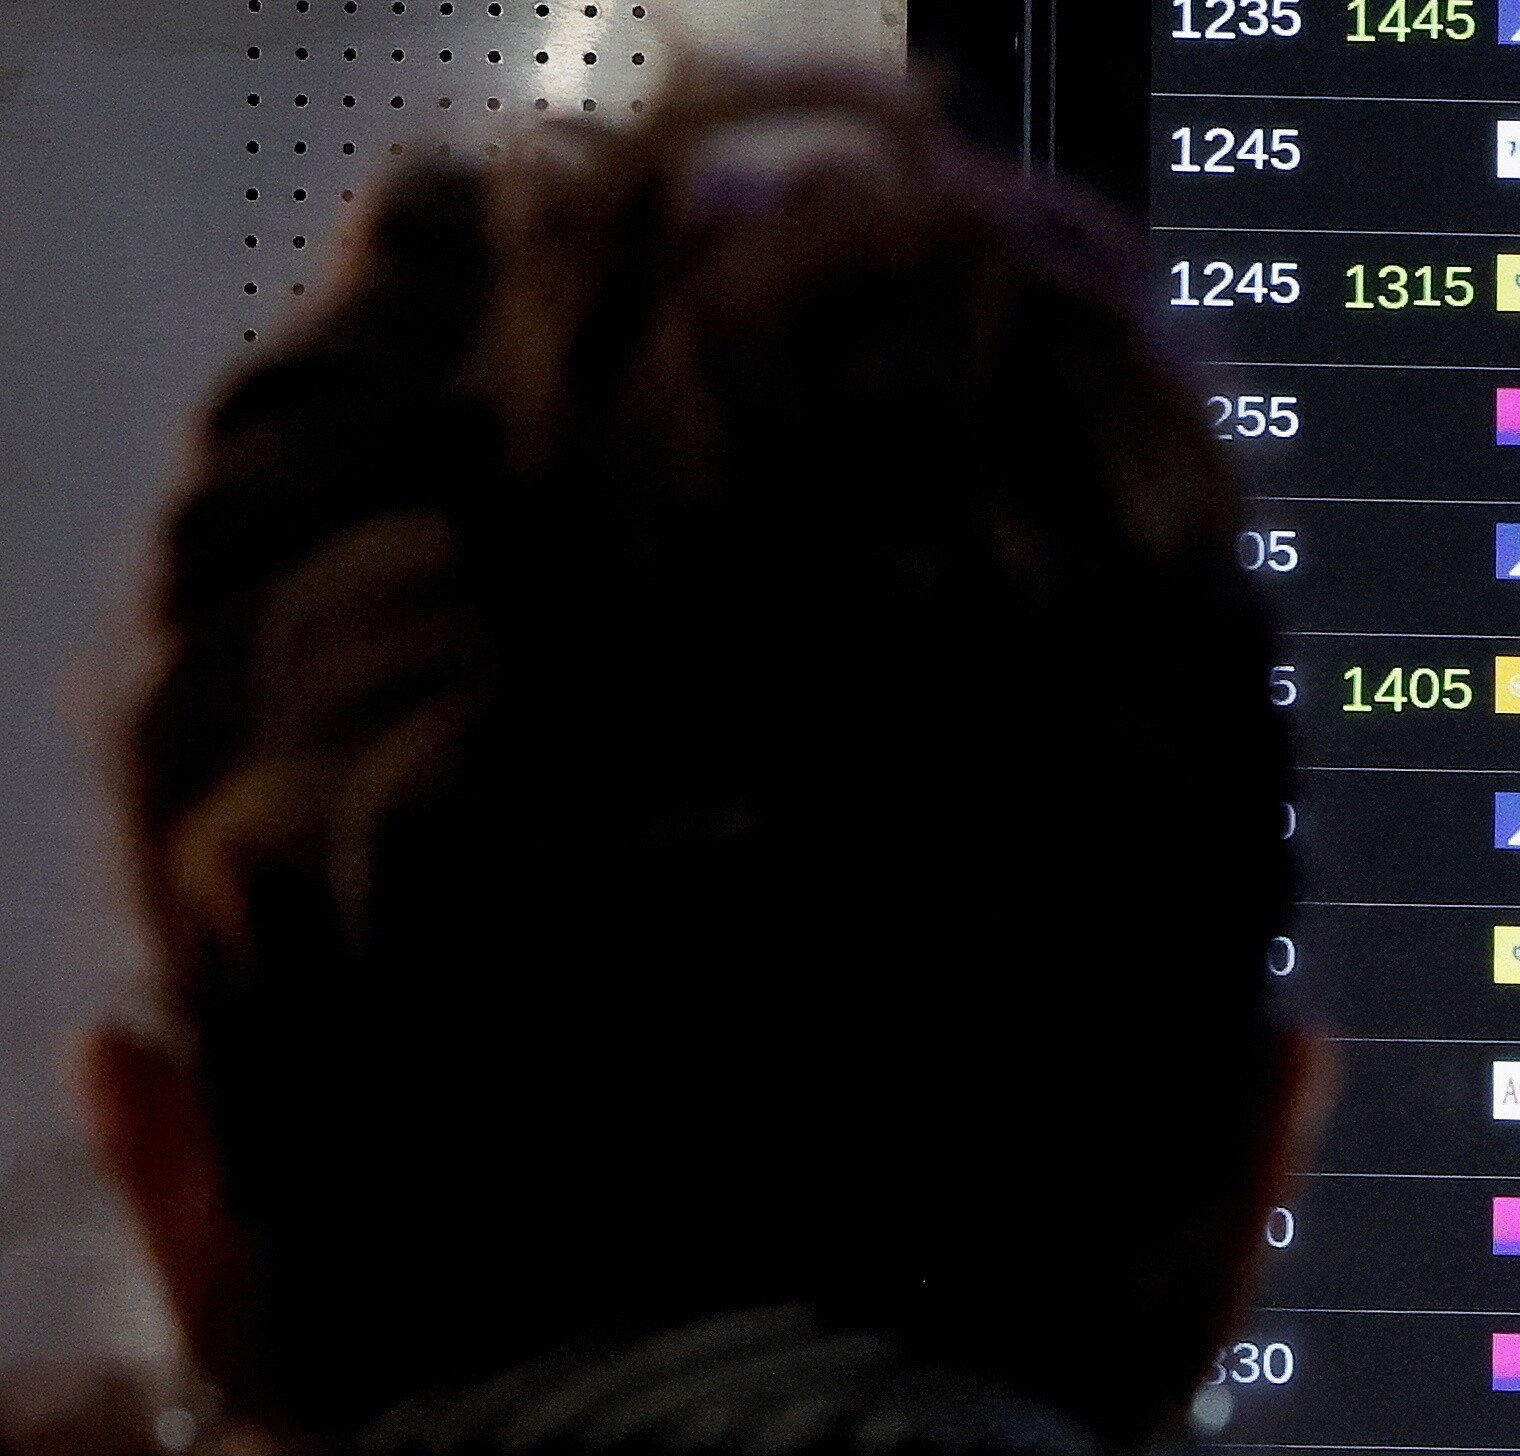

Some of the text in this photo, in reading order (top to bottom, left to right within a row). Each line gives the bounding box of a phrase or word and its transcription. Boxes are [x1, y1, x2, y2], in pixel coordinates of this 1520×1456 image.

[1170, 127, 1301, 173] 1245
[1170, 260, 1300, 307] 1245
[1345, 264, 1474, 310] 1315
[1205, 395, 1300, 440] 255
[1342, 666, 1473, 713] 1405
